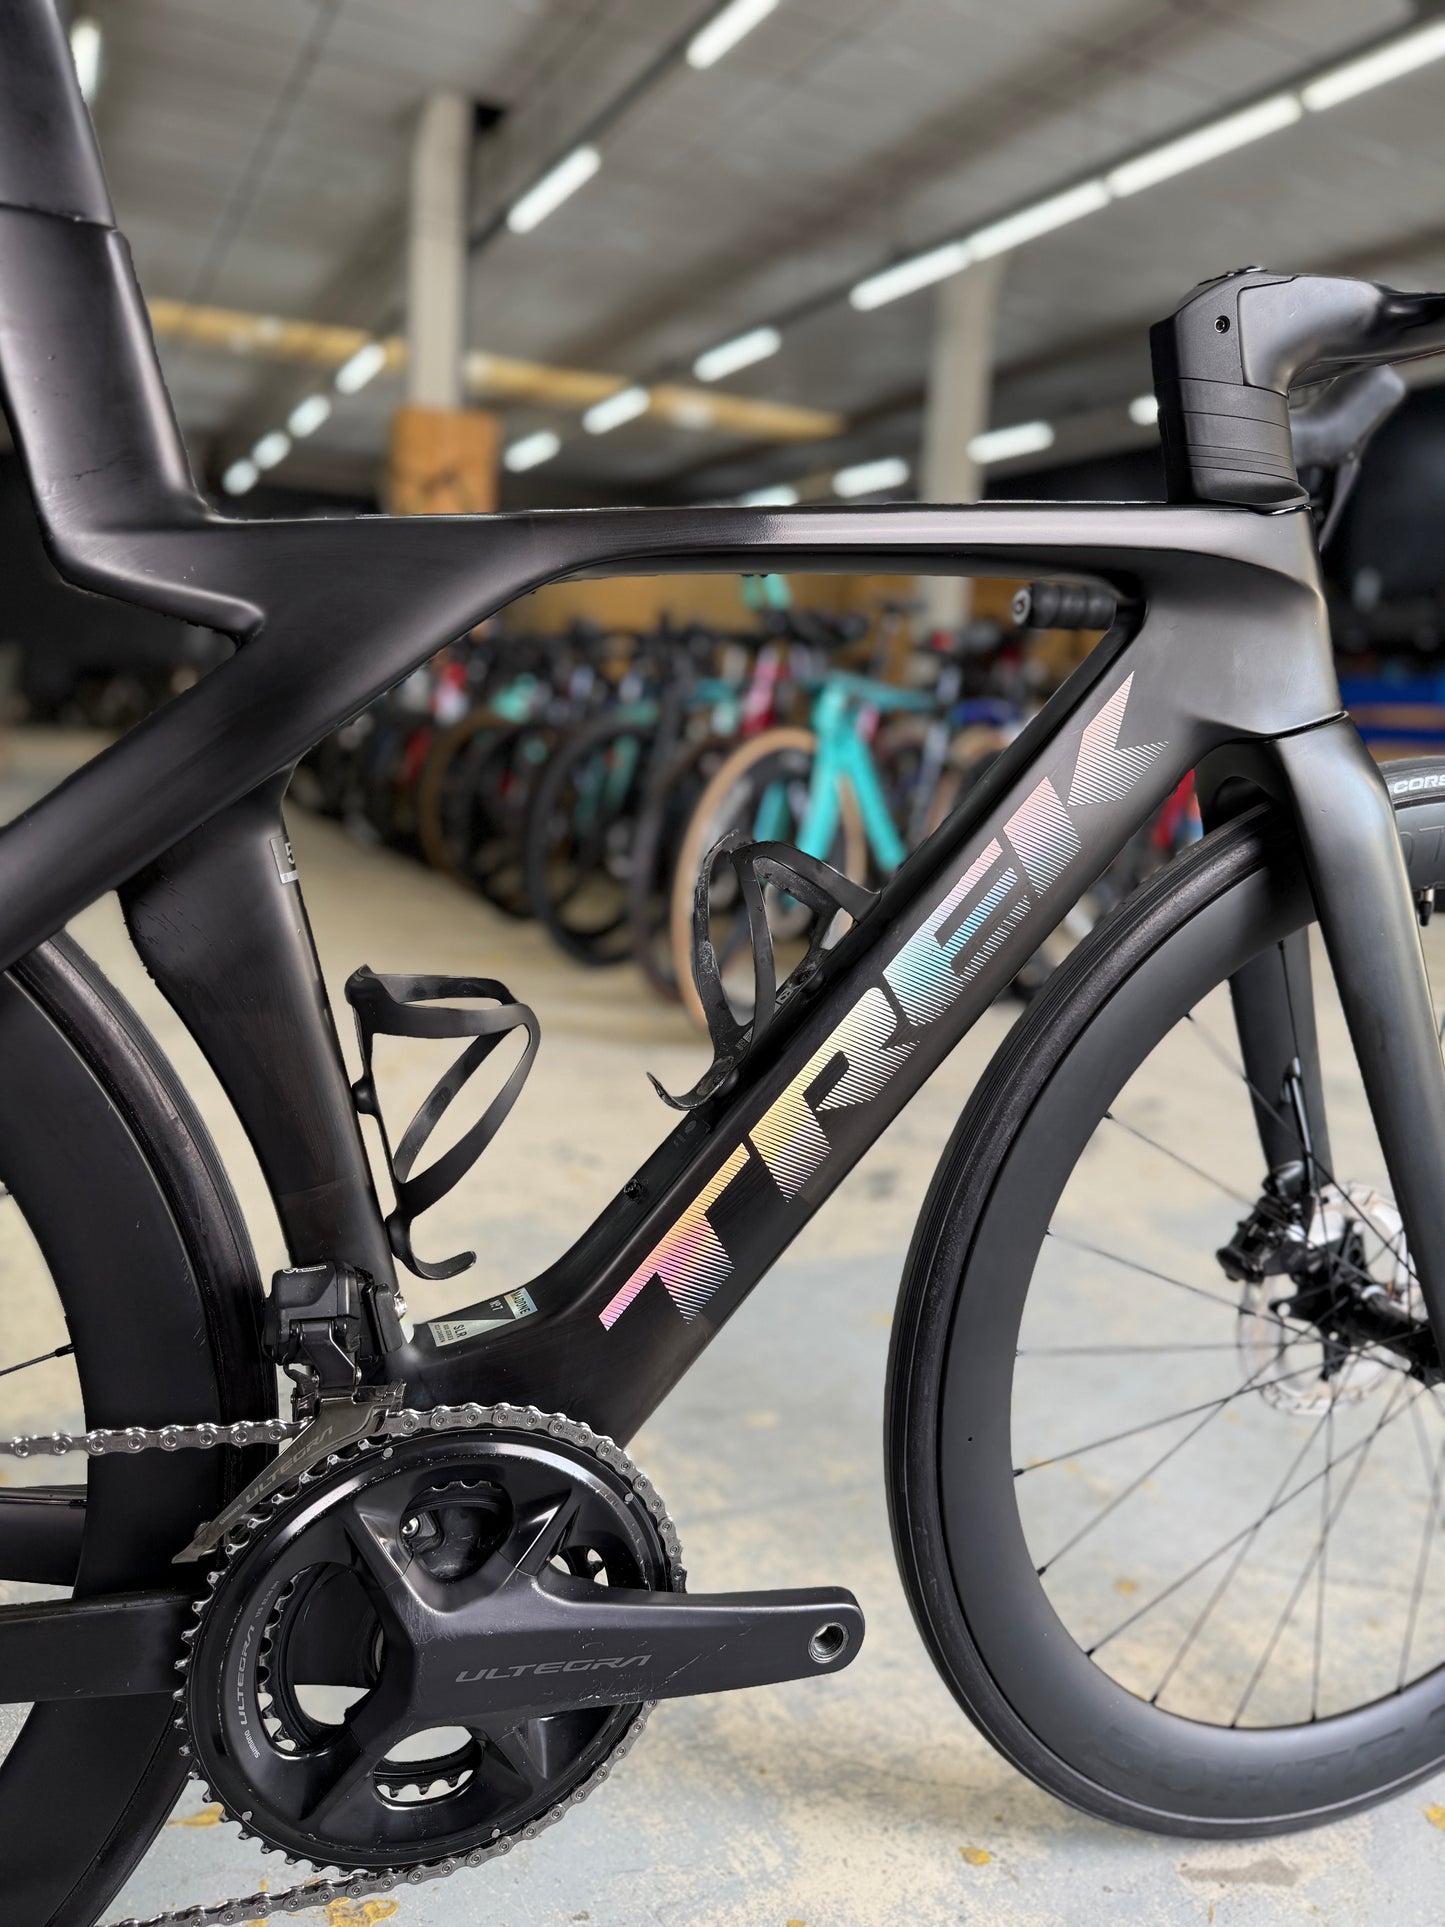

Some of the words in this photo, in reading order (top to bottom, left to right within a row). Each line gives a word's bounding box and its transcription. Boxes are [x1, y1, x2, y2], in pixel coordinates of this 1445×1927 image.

[599, 671, 1168, 1331] TREK
[511, 1290, 531, 1315] MADONE
[453, 1324, 467, 1338] SLR
[245, 1426, 333, 1503] ULTEGRA
[237, 1624, 255, 1725] ULTEGRA
[456, 1655, 652, 1682] ULTEGRA
[244, 1729, 260, 1758] SHIMANO
